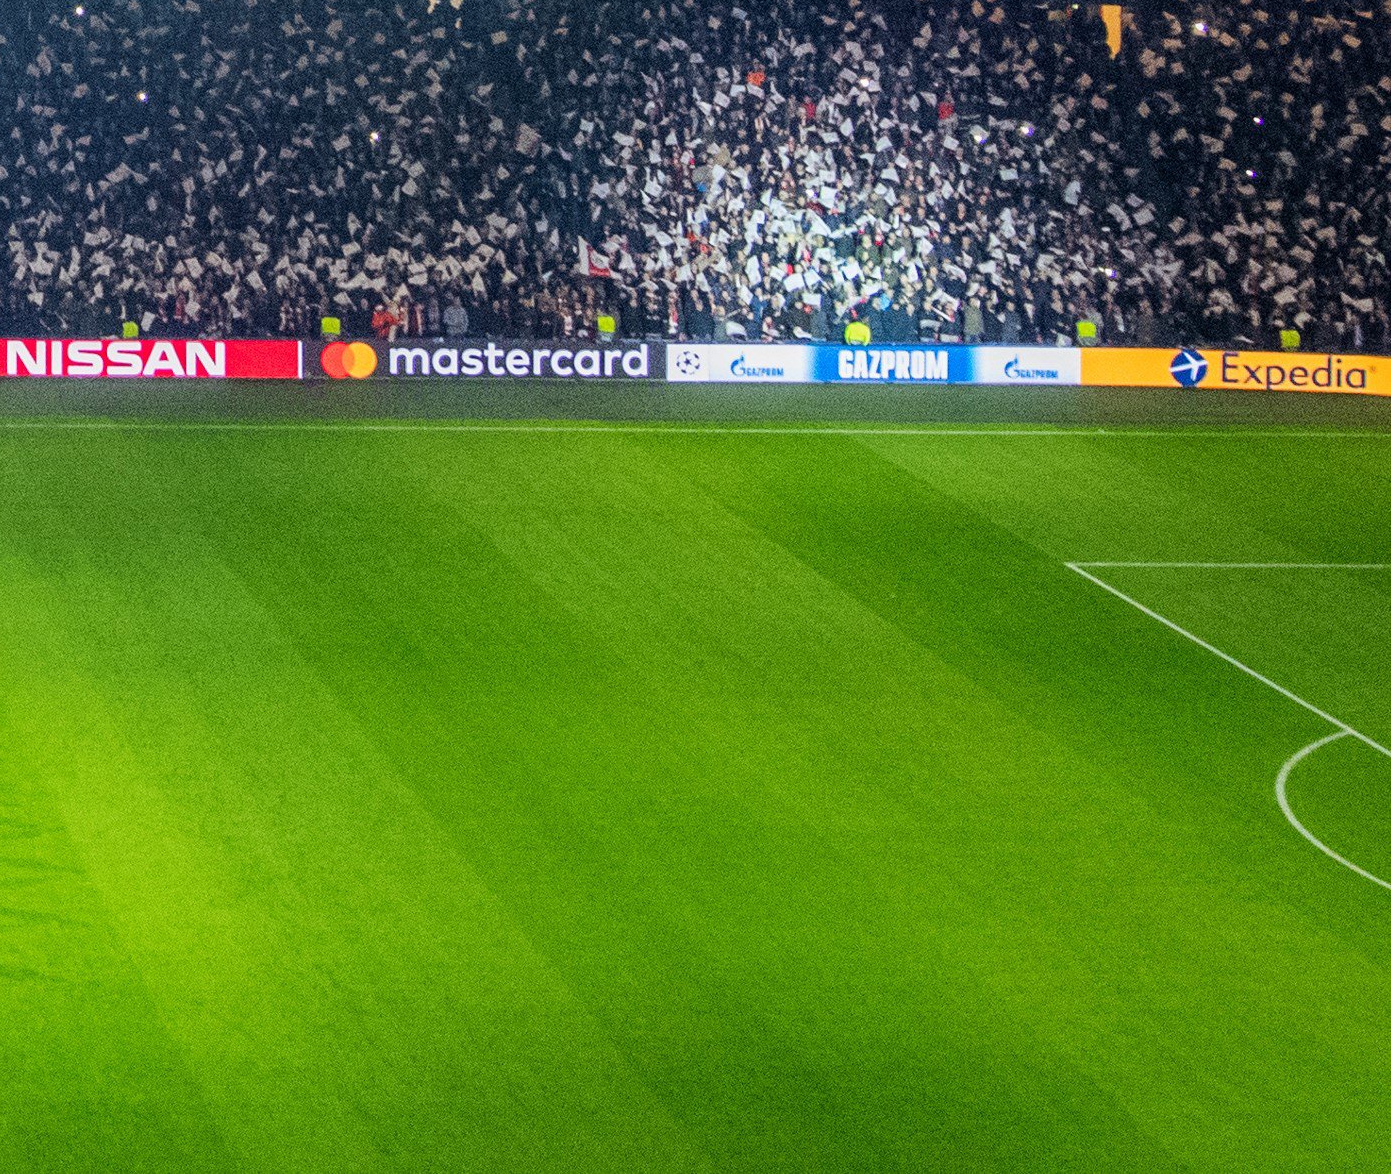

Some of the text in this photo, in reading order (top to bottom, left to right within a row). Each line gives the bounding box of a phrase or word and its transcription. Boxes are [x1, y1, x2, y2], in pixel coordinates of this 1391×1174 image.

[6, 340, 226, 376] NISSAN
[389, 343, 649, 378] mastercard
[838, 349, 948, 380] GAZPROM
[1221, 352, 1367, 391] Expedia
